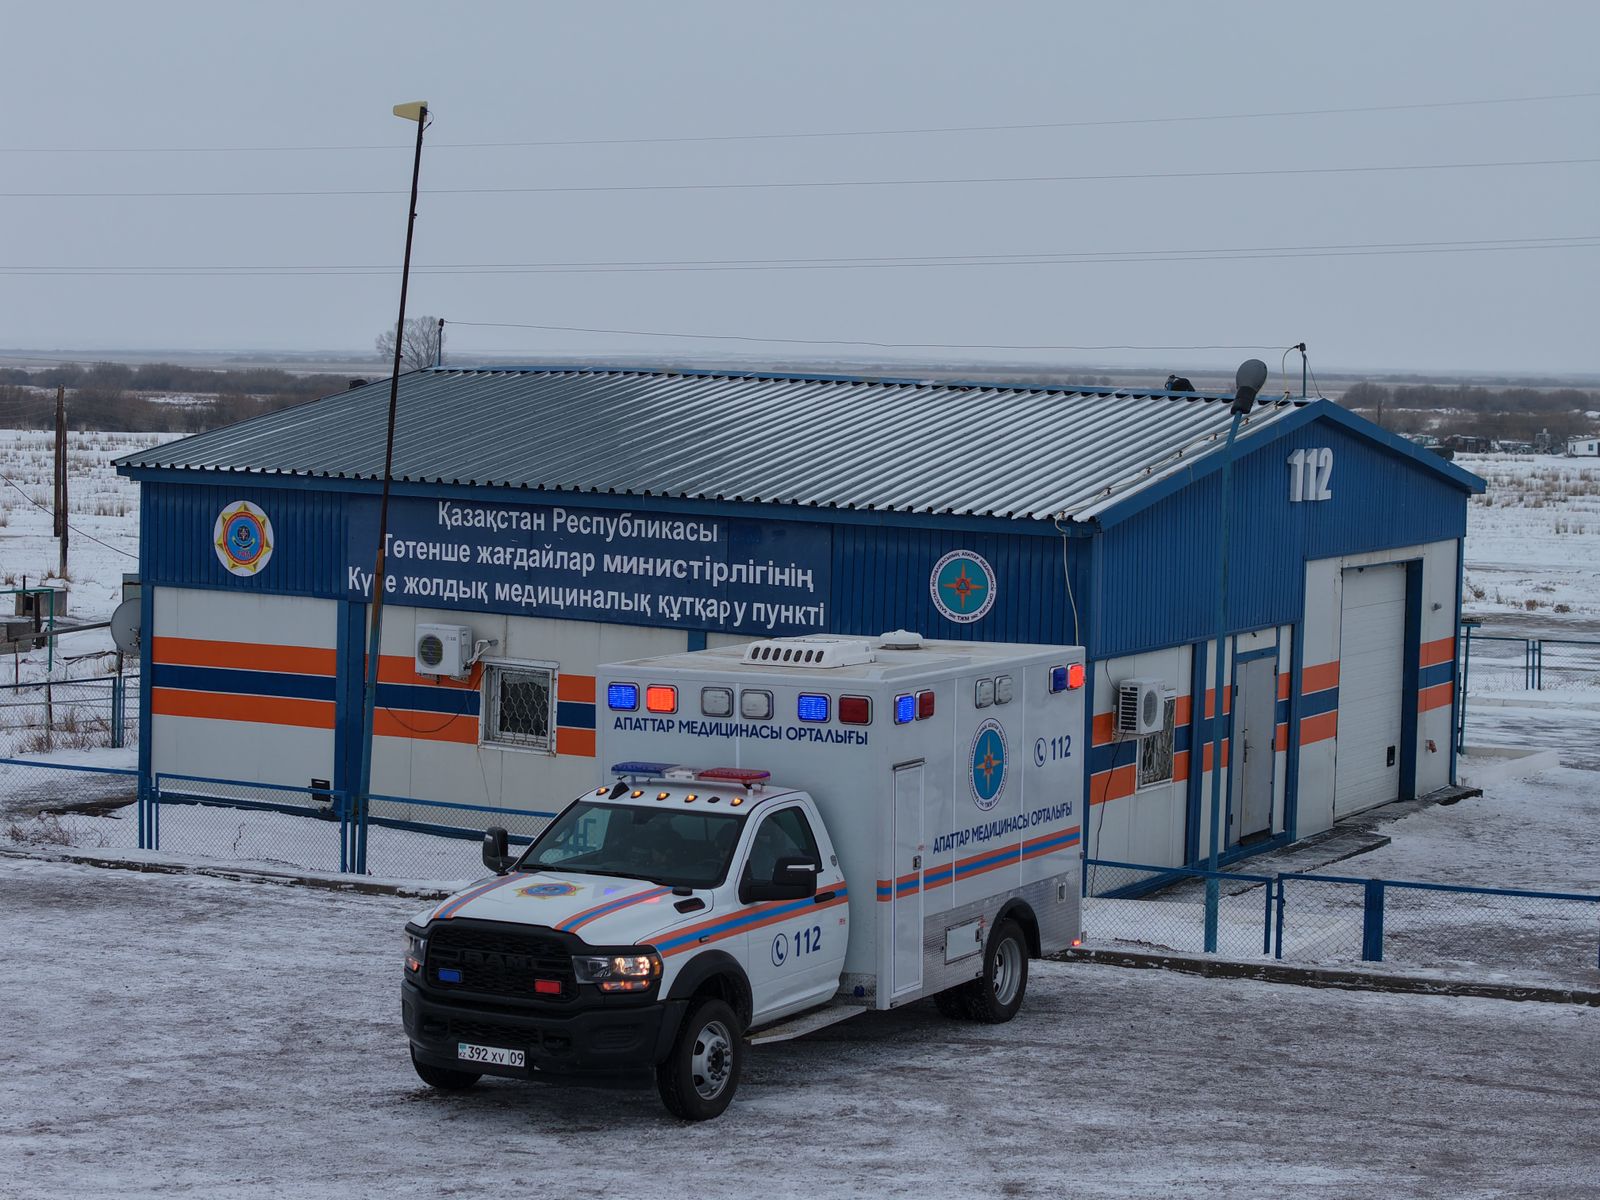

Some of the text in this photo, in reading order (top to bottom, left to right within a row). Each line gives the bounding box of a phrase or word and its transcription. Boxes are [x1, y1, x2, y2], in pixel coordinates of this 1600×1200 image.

[1286, 447, 1333, 502] 112
[438, 501, 718, 543] Қазақстан Республикасы
[384, 533, 814, 593] Төтенше жағдайлар министірлігінің
[348, 566, 825, 630] Күе жолдық медициналық құтқару пункті
[614, 716, 868, 746] АПАТТАР МЕДИЦИНАСЫ ОРТАЛЫҒЫ
[1050, 734, 1072, 761] 112
[933, 800, 1073, 855] АПАТТАР МЕДИЦИНАСЫ ОРТАЛЫҒЫ
[794, 925, 822, 957] 112
[468, 1046, 488, 1061] 392
[491, 1052, 505, 1063] XV
[510, 1052, 524, 1065] 09
